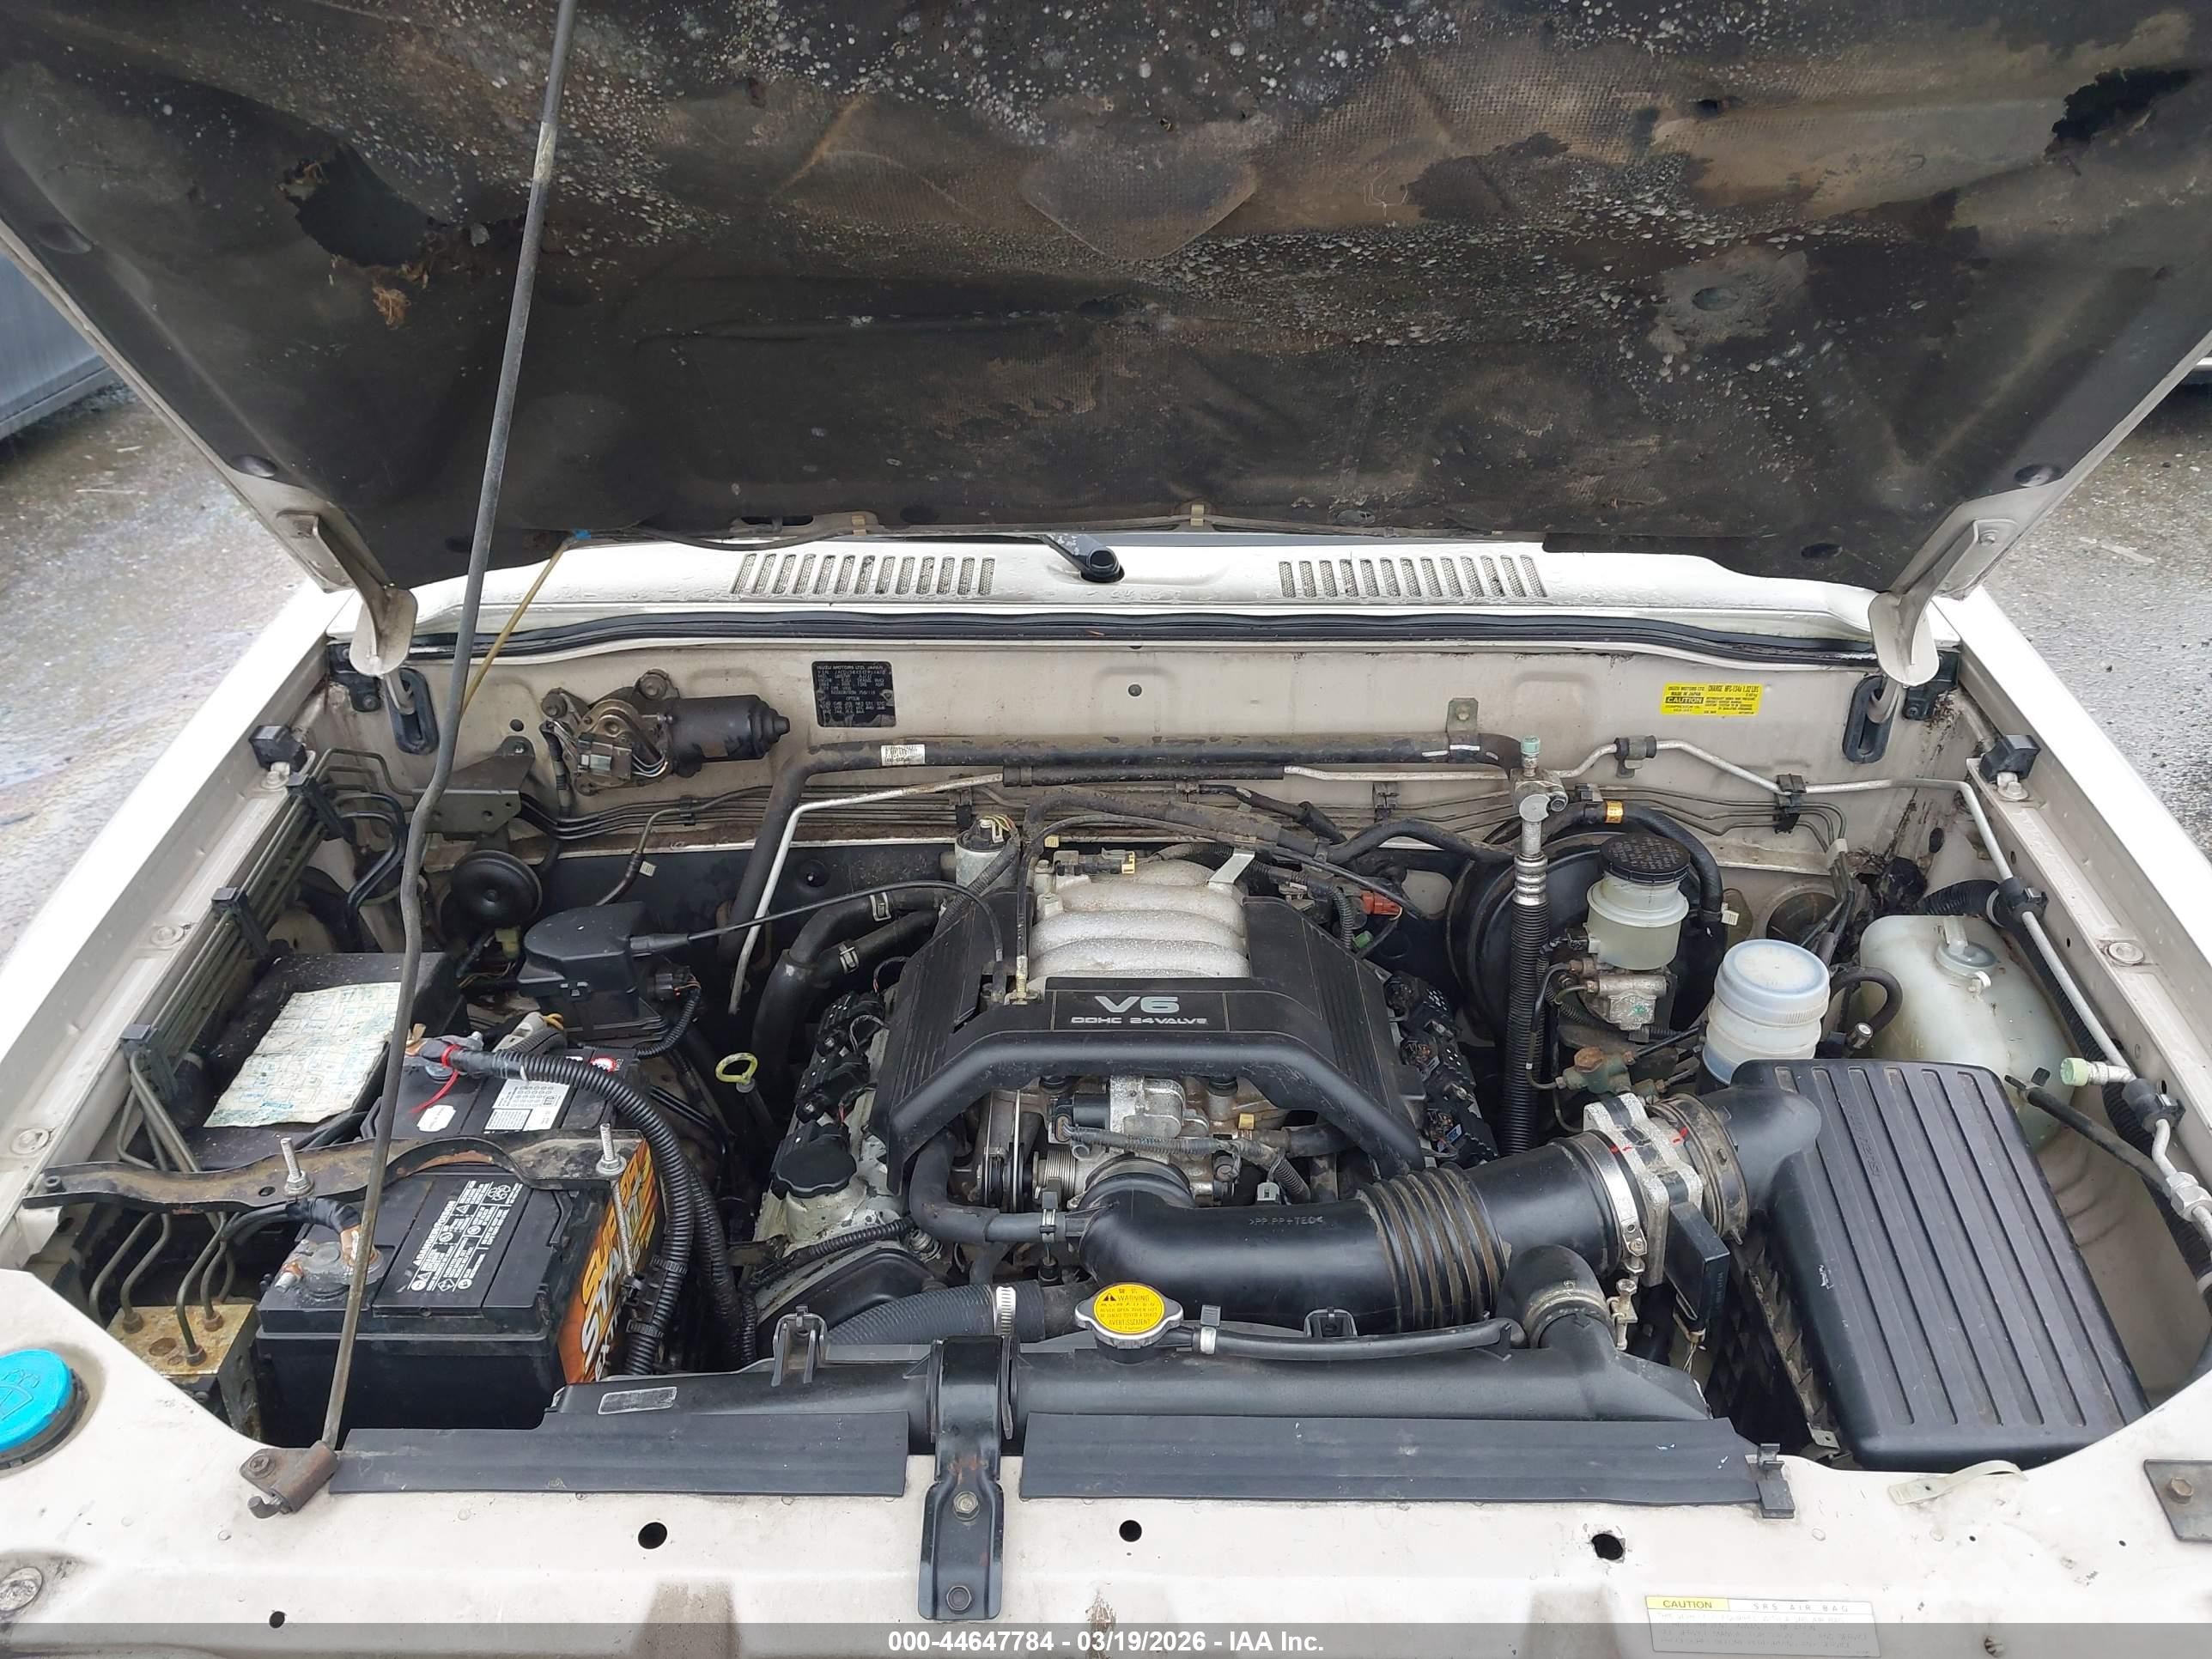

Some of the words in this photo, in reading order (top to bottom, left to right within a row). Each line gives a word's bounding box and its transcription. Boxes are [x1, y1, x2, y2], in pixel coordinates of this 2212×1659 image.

[1094, 995, 1180, 1014] V6
[1662, 1600, 1713, 1609] CAUTION
[1822, 1604, 1849, 1613] BAG
